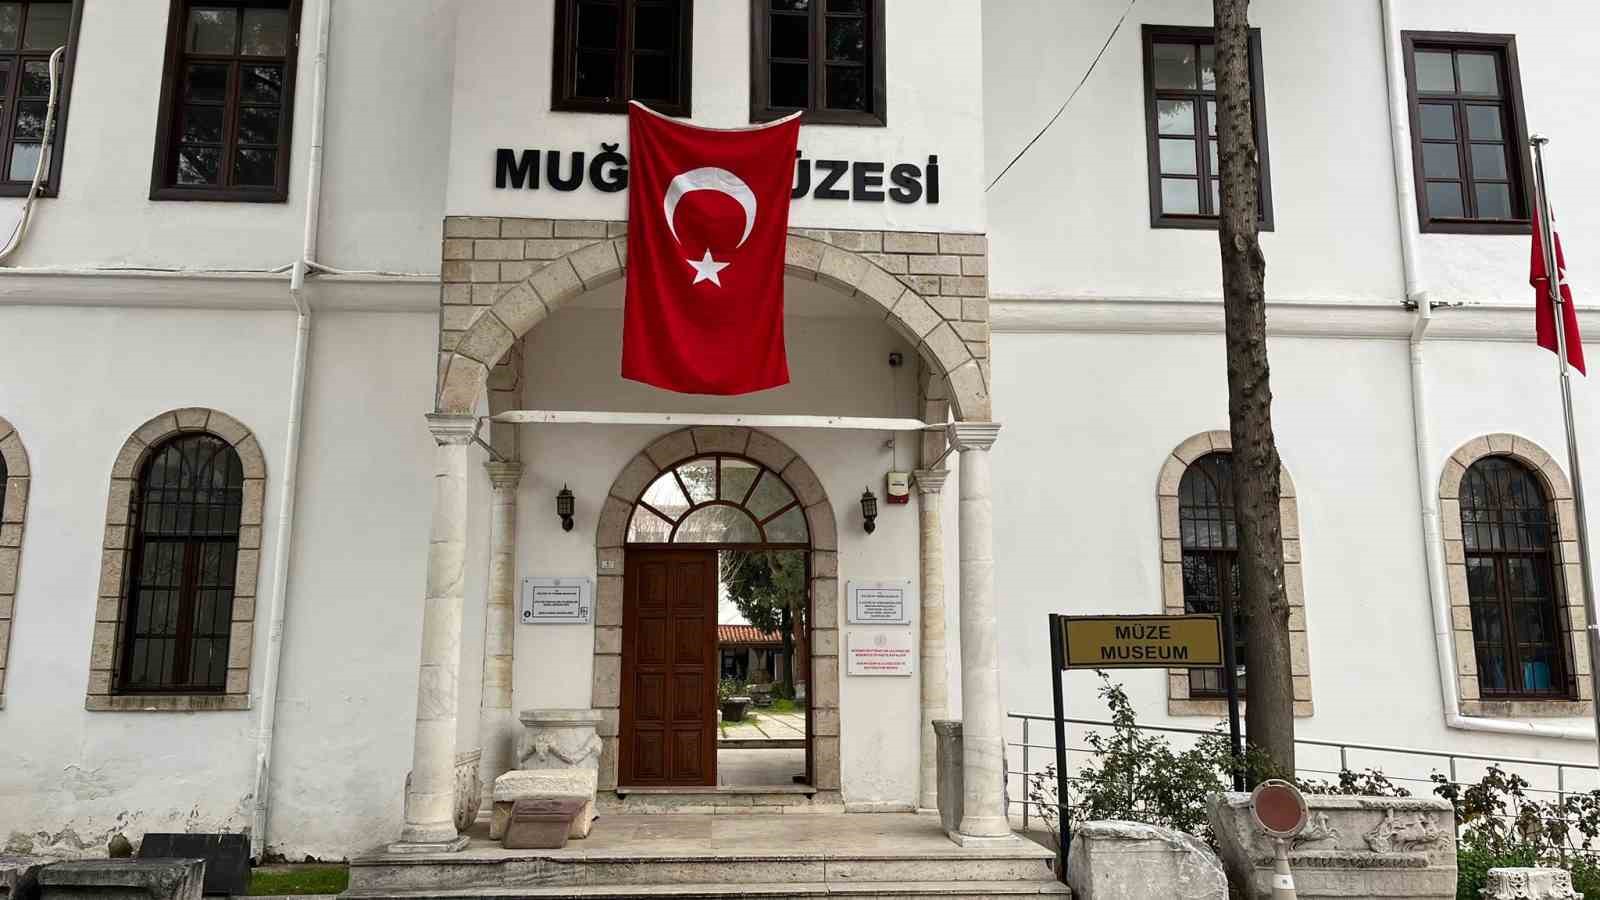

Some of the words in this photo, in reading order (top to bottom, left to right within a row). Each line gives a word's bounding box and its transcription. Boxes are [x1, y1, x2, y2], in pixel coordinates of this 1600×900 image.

[496, 142, 629, 193] MUĞ
[790, 149, 940, 204] ÜZESİ
[1115, 623, 1171, 640] MÜZE
[1100, 645, 1189, 660] MUSEUM
